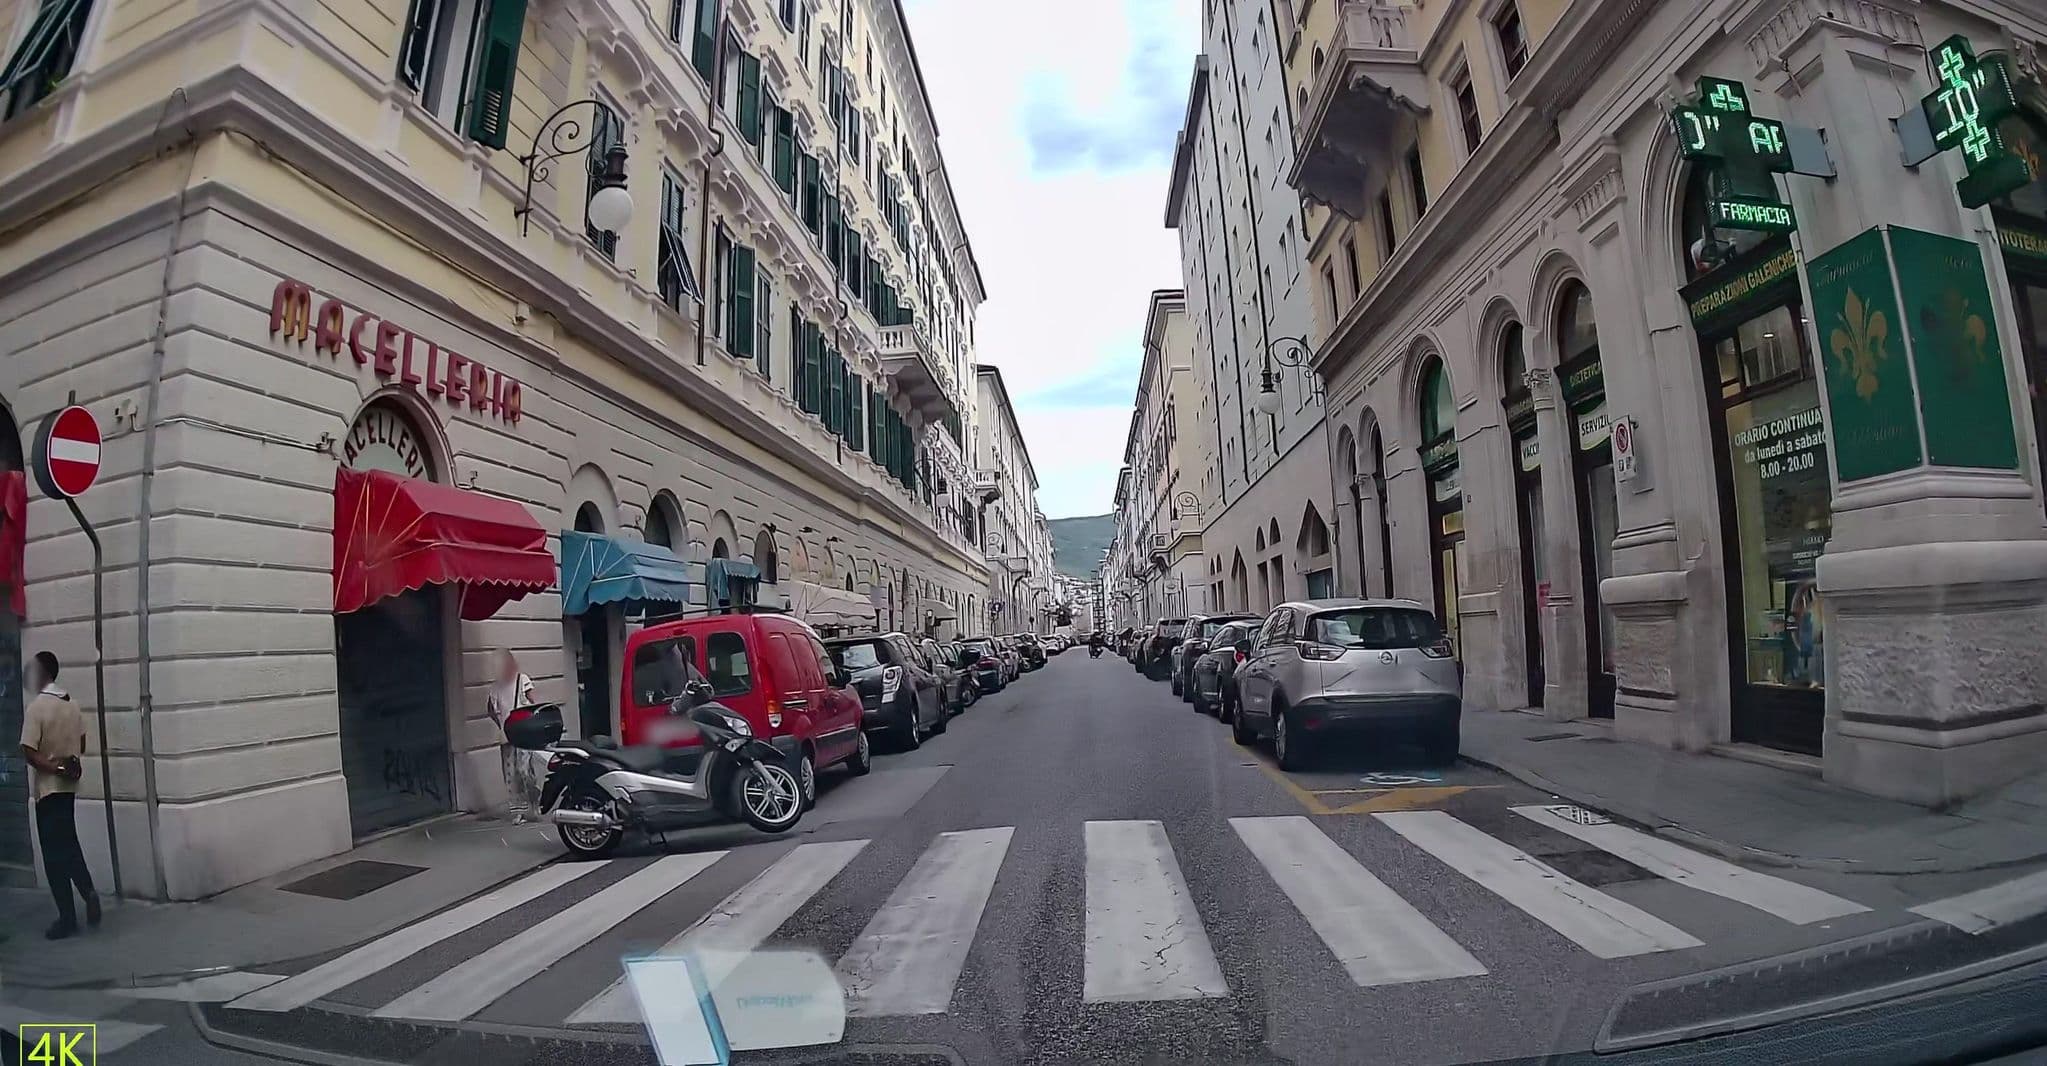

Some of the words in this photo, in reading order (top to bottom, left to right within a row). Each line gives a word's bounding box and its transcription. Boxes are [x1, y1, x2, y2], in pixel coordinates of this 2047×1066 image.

[1720, 202, 1791, 226] FARMACIA
[1690, 277, 1749, 320] PREPARAZIONI
[1747, 249, 1797, 289] GALENICHE
[270, 278, 522, 423] MACELLERIA
[341, 411, 424, 479] ACELLERI
[1734, 425, 1769, 447] ORARIO
[1770, 407, 1823, 437] CONTINUA
[1744, 449, 1756, 464] da
[1786, 440, 1793, 453] a
[1760, 461, 1780, 479] 8.00
[1787, 452, 1814, 473] 20.00
